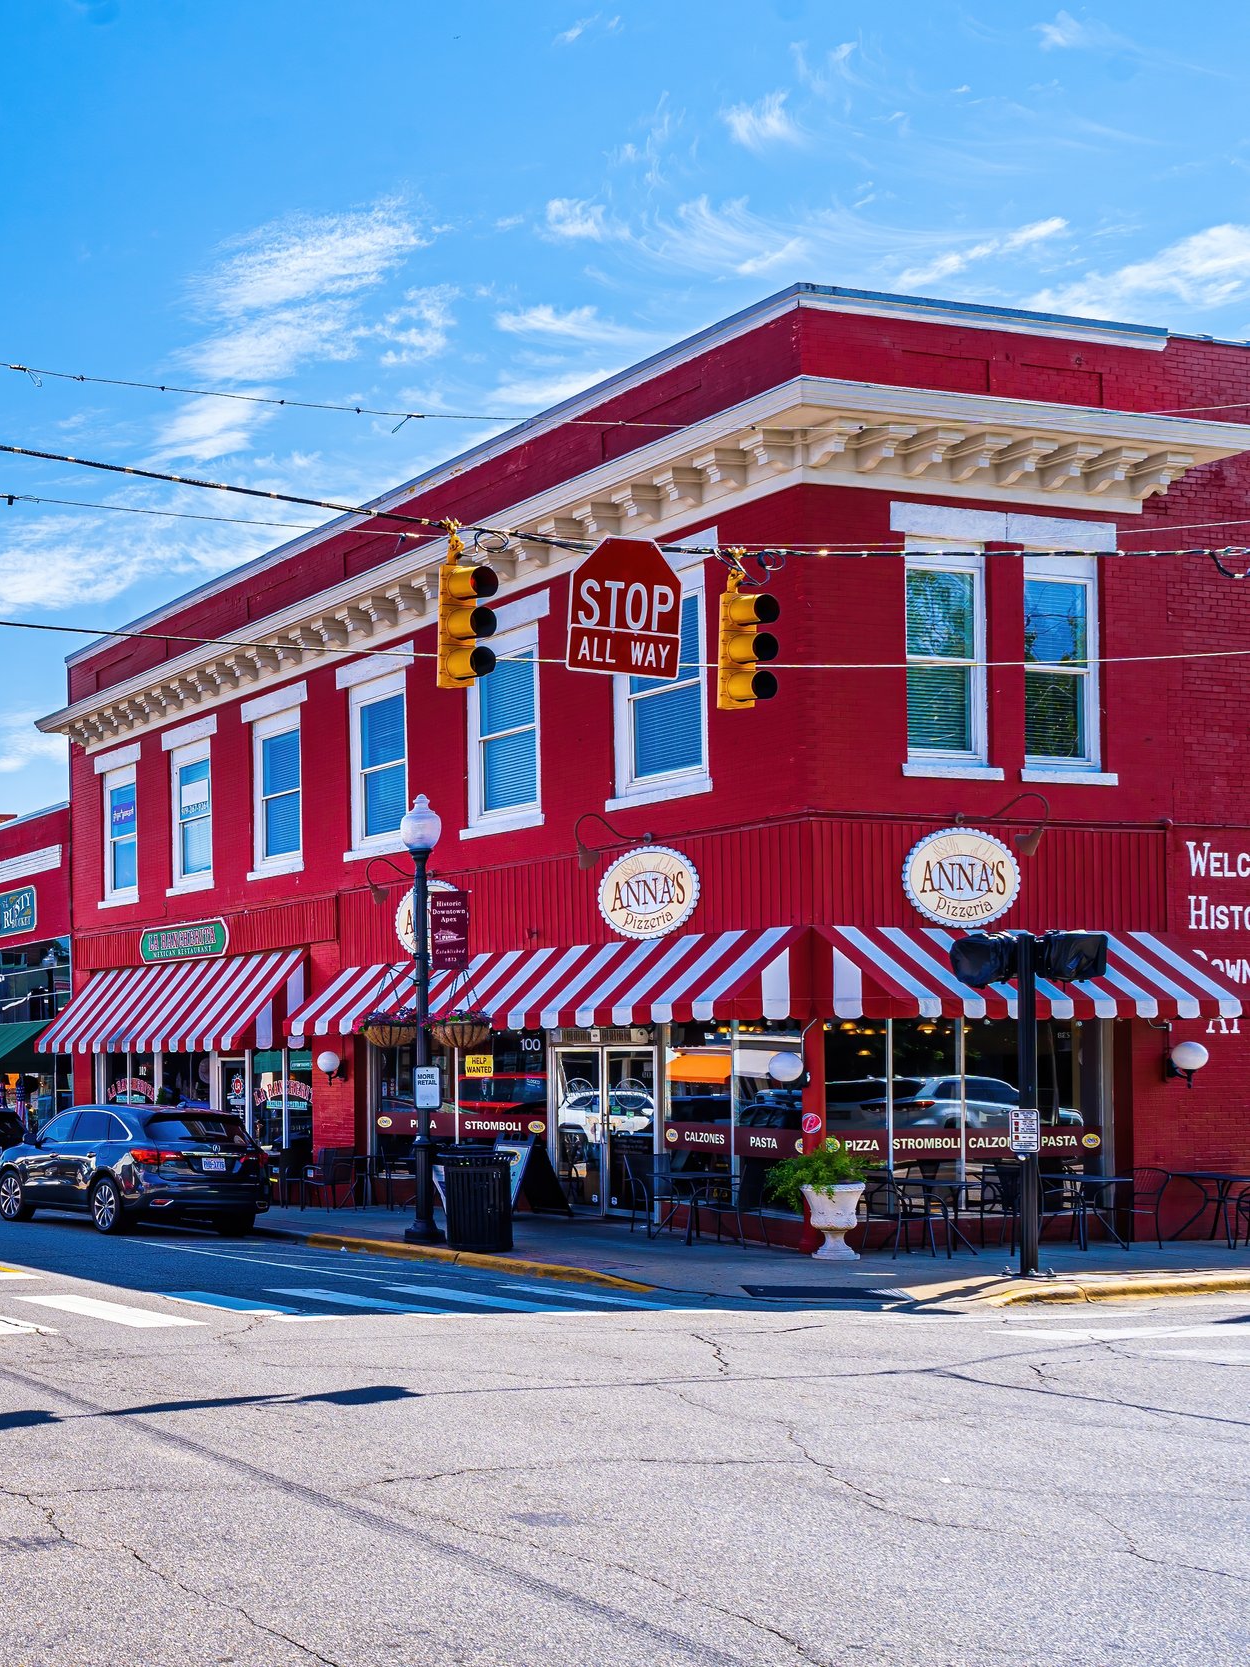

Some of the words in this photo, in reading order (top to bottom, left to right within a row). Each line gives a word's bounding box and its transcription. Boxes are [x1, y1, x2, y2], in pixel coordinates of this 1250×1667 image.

[578, 579, 674, 631] STOP
[578, 636, 616, 664] ALL
[630, 641, 670, 669] WAY
[920, 860, 1006, 895] ANNA'S
[610, 871, 685, 912] ANNA'S
[4, 892, 32, 928] RUSTY
[934, 896, 993, 918] Pizzeria
[622, 912, 674, 930] Pizzeria
[148, 934, 159, 952] LA
[160, 926, 216, 950] RANCHERITA
[152, 950, 176, 958] MEXICAN
[178, 945, 212, 956] RESTAURANT
[520, 1038, 541, 1050] 100
[472, 1056, 487, 1065] HELP
[466, 1066, 492, 1074] WANTED
[253, 1088, 266, 1106] LA
[410, 1119, 437, 1128] PIA
[464, 1120, 522, 1131] STROMBOLI
[684, 1131, 724, 1145] CALZONES
[750, 1136, 778, 1149] PASTA
[845, 1140, 879, 1151] PIZZA
[892, 1138, 961, 1150] STROMBOLI
[968, 1136, 1010, 1148] CALZO
[1041, 1136, 1078, 1146] PASTA
